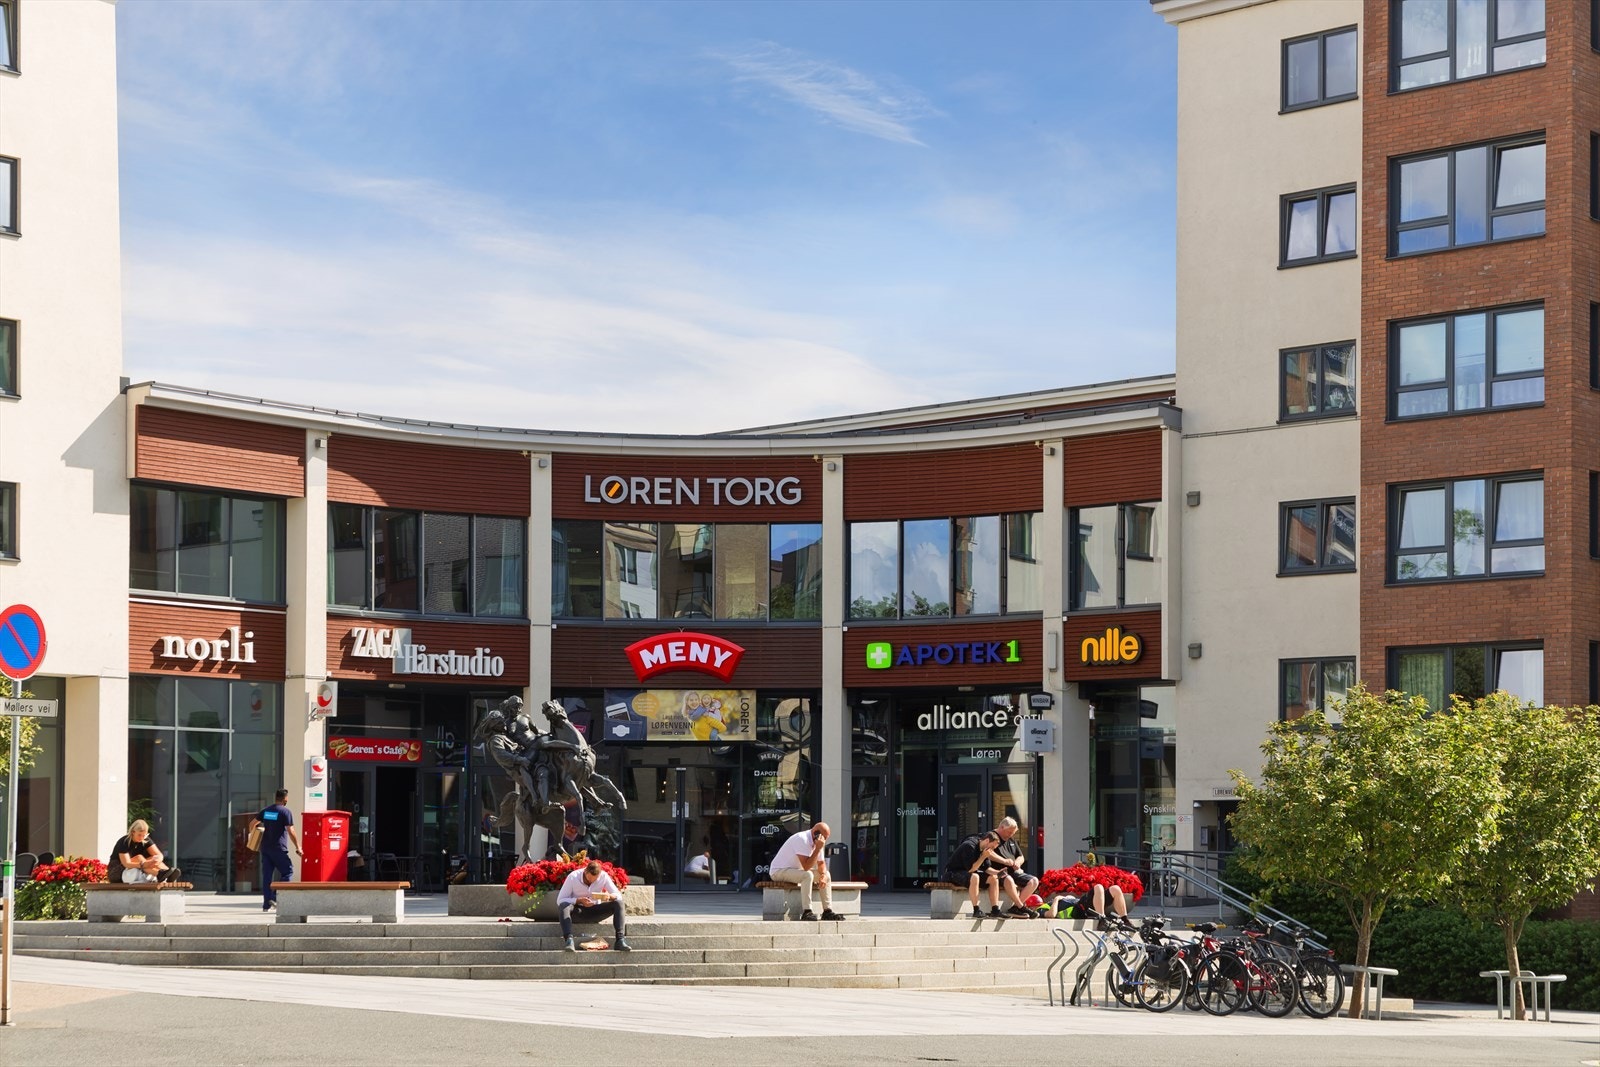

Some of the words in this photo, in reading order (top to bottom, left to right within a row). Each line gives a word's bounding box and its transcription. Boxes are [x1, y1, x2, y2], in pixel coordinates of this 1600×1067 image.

[706, 476, 802, 506] TORG
[160, 625, 257, 663] norli
[350, 627, 404, 659] ZAGA
[638, 641, 733, 669] MENY
[896, 642, 1004, 667] APOTEK
[1005, 640, 1022, 663] 1
[1080, 627, 1140, 663] nille
[403, 643, 505, 677] Hårstudio
[4, 701, 34, 713] Møllers
[37, 703, 51, 714] vei
[760, 752, 782, 761] MENY
[970, 746, 1002, 759] Løren
[896, 807, 936, 819] Synsklinikk
[761, 824, 780, 835] nille
